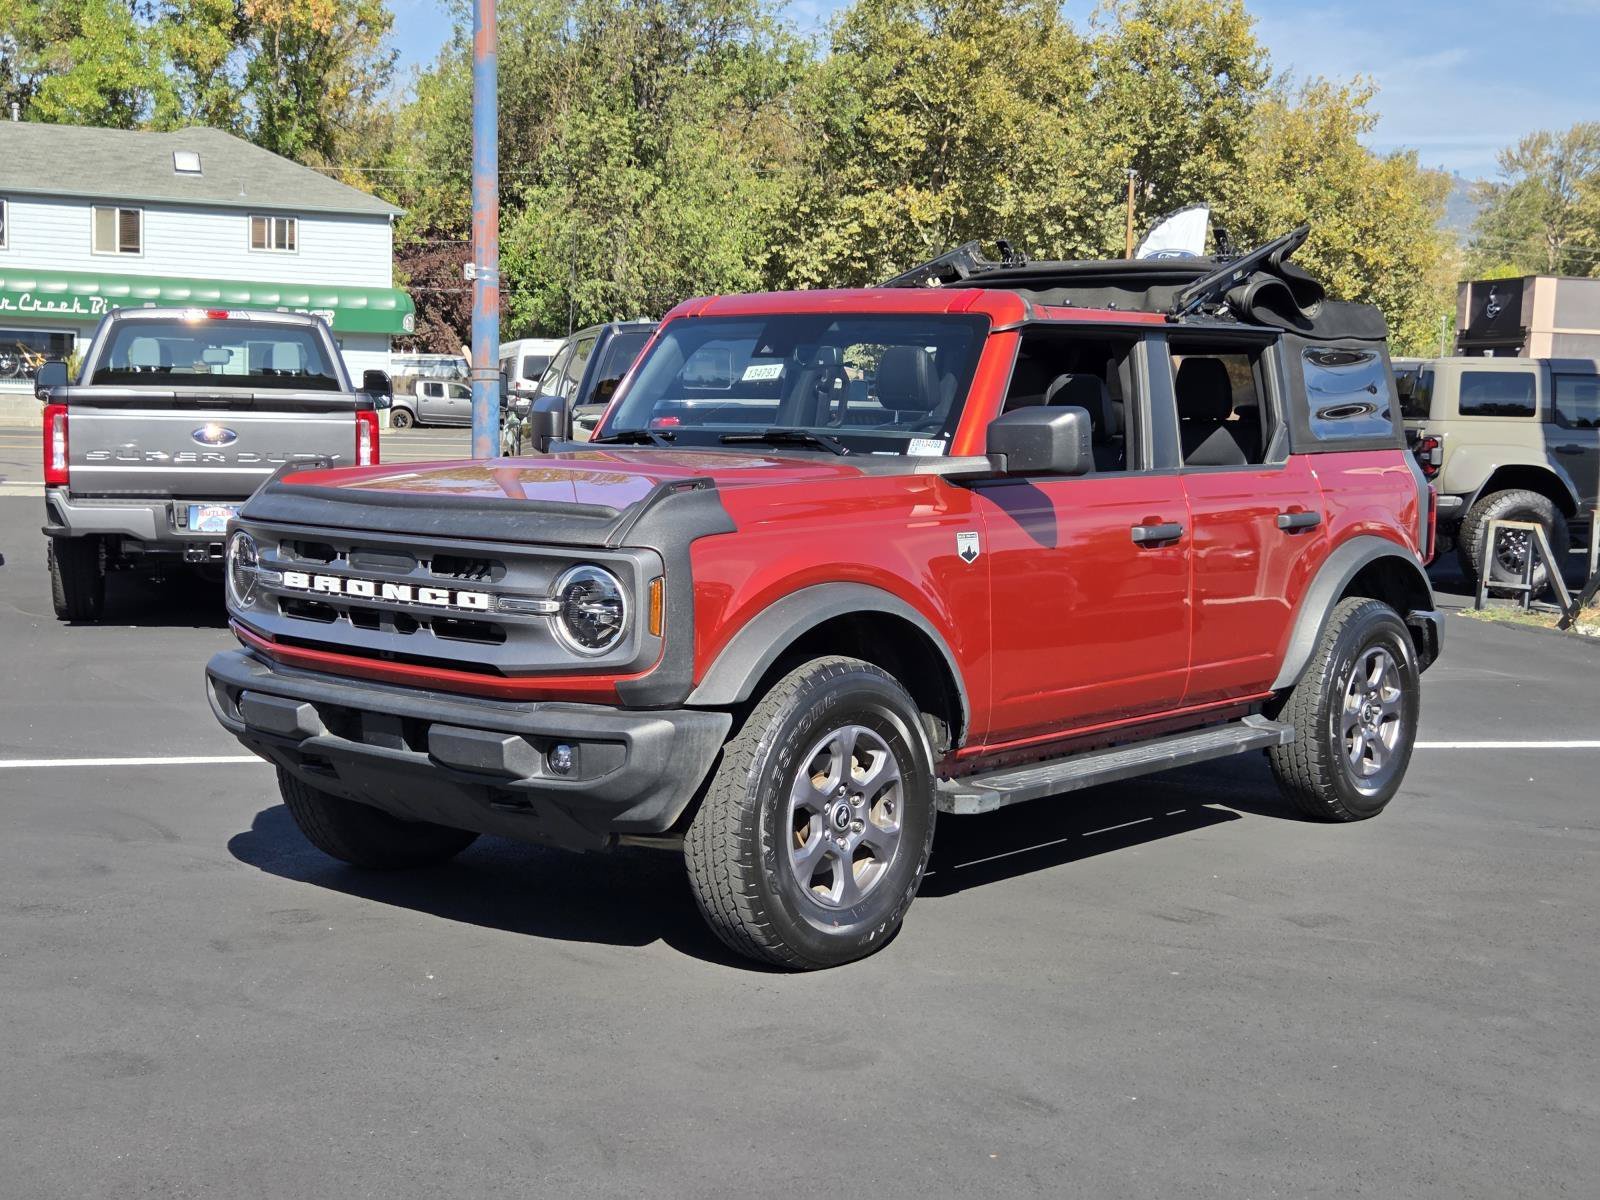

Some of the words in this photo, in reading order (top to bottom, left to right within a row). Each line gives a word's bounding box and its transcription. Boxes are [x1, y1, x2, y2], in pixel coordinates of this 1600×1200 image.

[19, 293, 88, 313] Creek
[86, 450, 226, 462] SUPER
[284, 571, 489, 610] BRONCO
